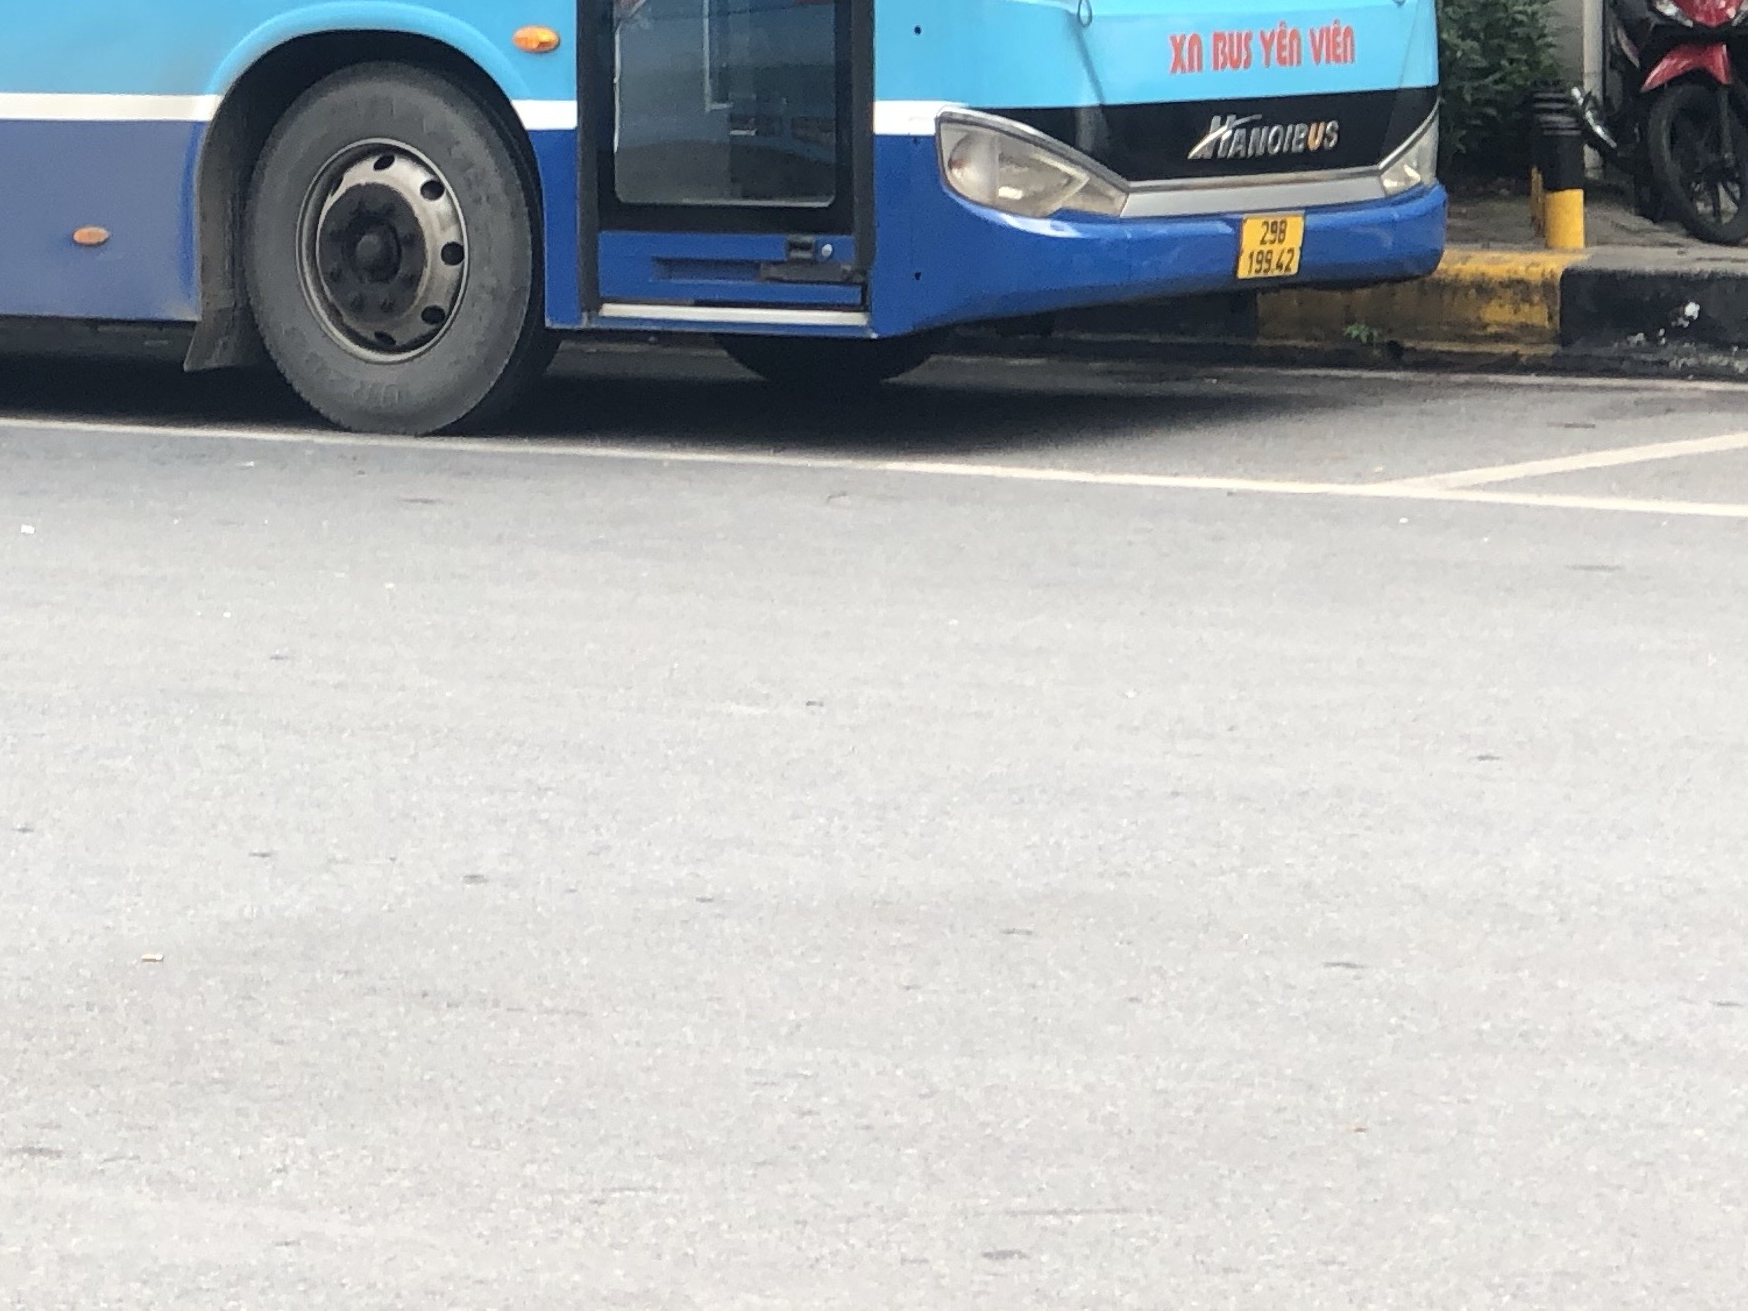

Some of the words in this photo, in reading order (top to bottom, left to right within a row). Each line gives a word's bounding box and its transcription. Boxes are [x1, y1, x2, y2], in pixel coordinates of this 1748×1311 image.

[1212, 29, 1252, 70] BUS
[1187, 114, 1340, 160] HANOIBUS
[1260, 220, 1288, 246] 29B
